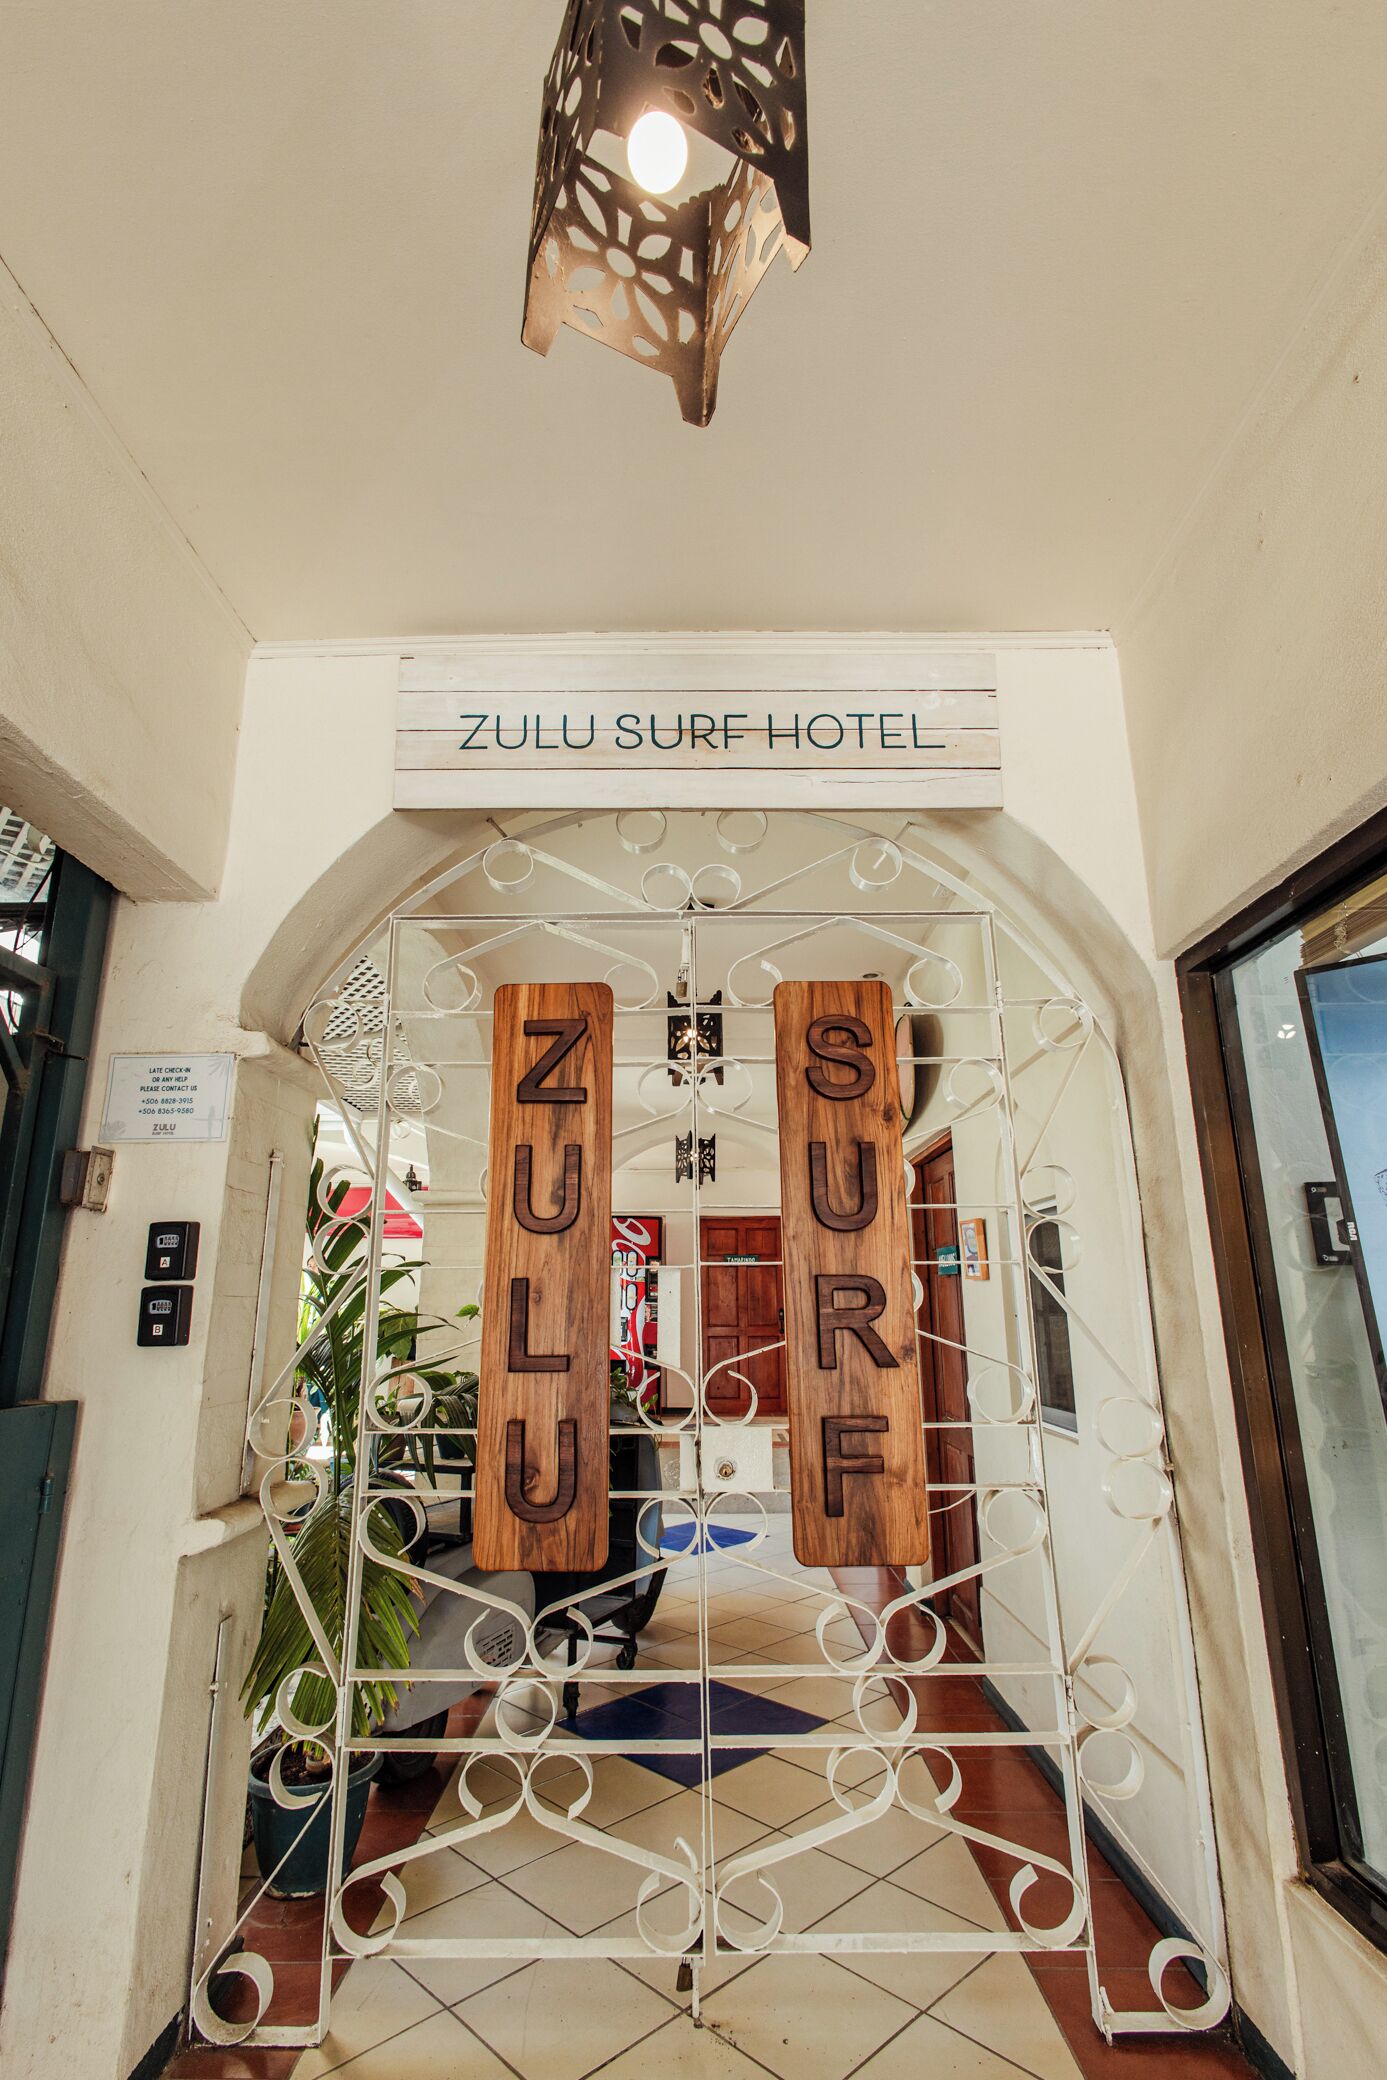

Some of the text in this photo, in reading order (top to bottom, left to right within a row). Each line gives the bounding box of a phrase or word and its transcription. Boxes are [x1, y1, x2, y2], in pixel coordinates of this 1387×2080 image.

[458, 712, 947, 750] ZULU SURF HOTEL
[138, 1107, 156, 1115] +506
[153, 1123, 176, 1131] ZULU
[504, 1018, 588, 1524] ZULU
[805, 1013, 901, 1518] SURF
[154, 1325, 161, 1333] B
